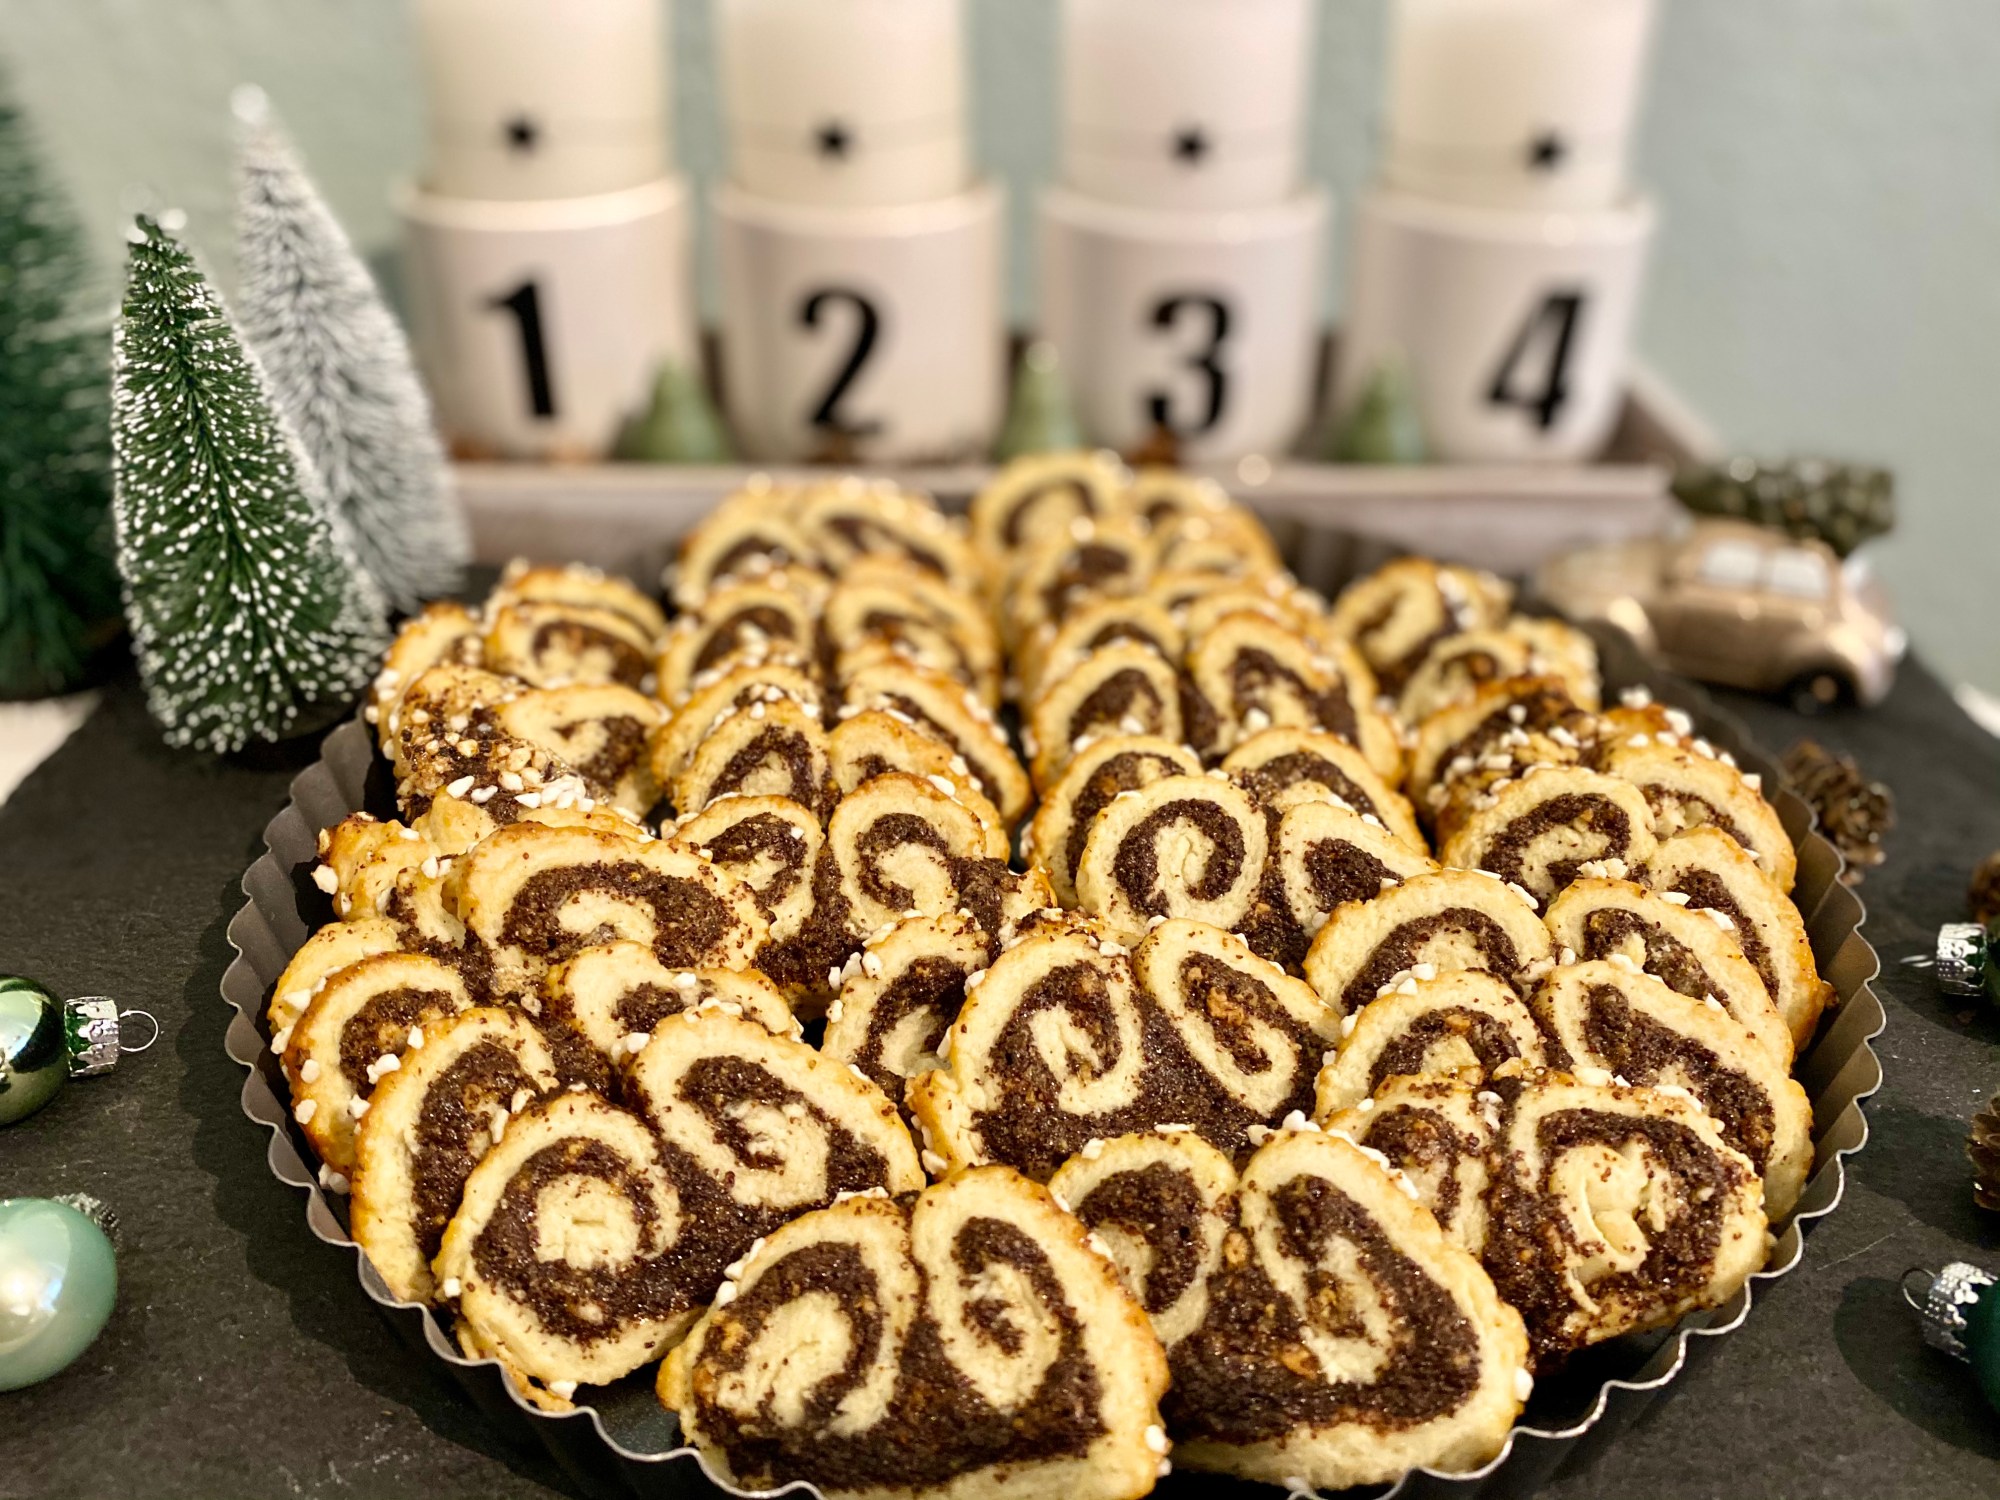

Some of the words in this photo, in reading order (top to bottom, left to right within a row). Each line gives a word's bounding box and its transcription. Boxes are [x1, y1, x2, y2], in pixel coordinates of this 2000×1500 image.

[480, 277, 560, 422] 1
[796, 286, 883, 438] 2
[1144, 291, 1233, 440] 3
[1484, 289, 1587, 431] 4
